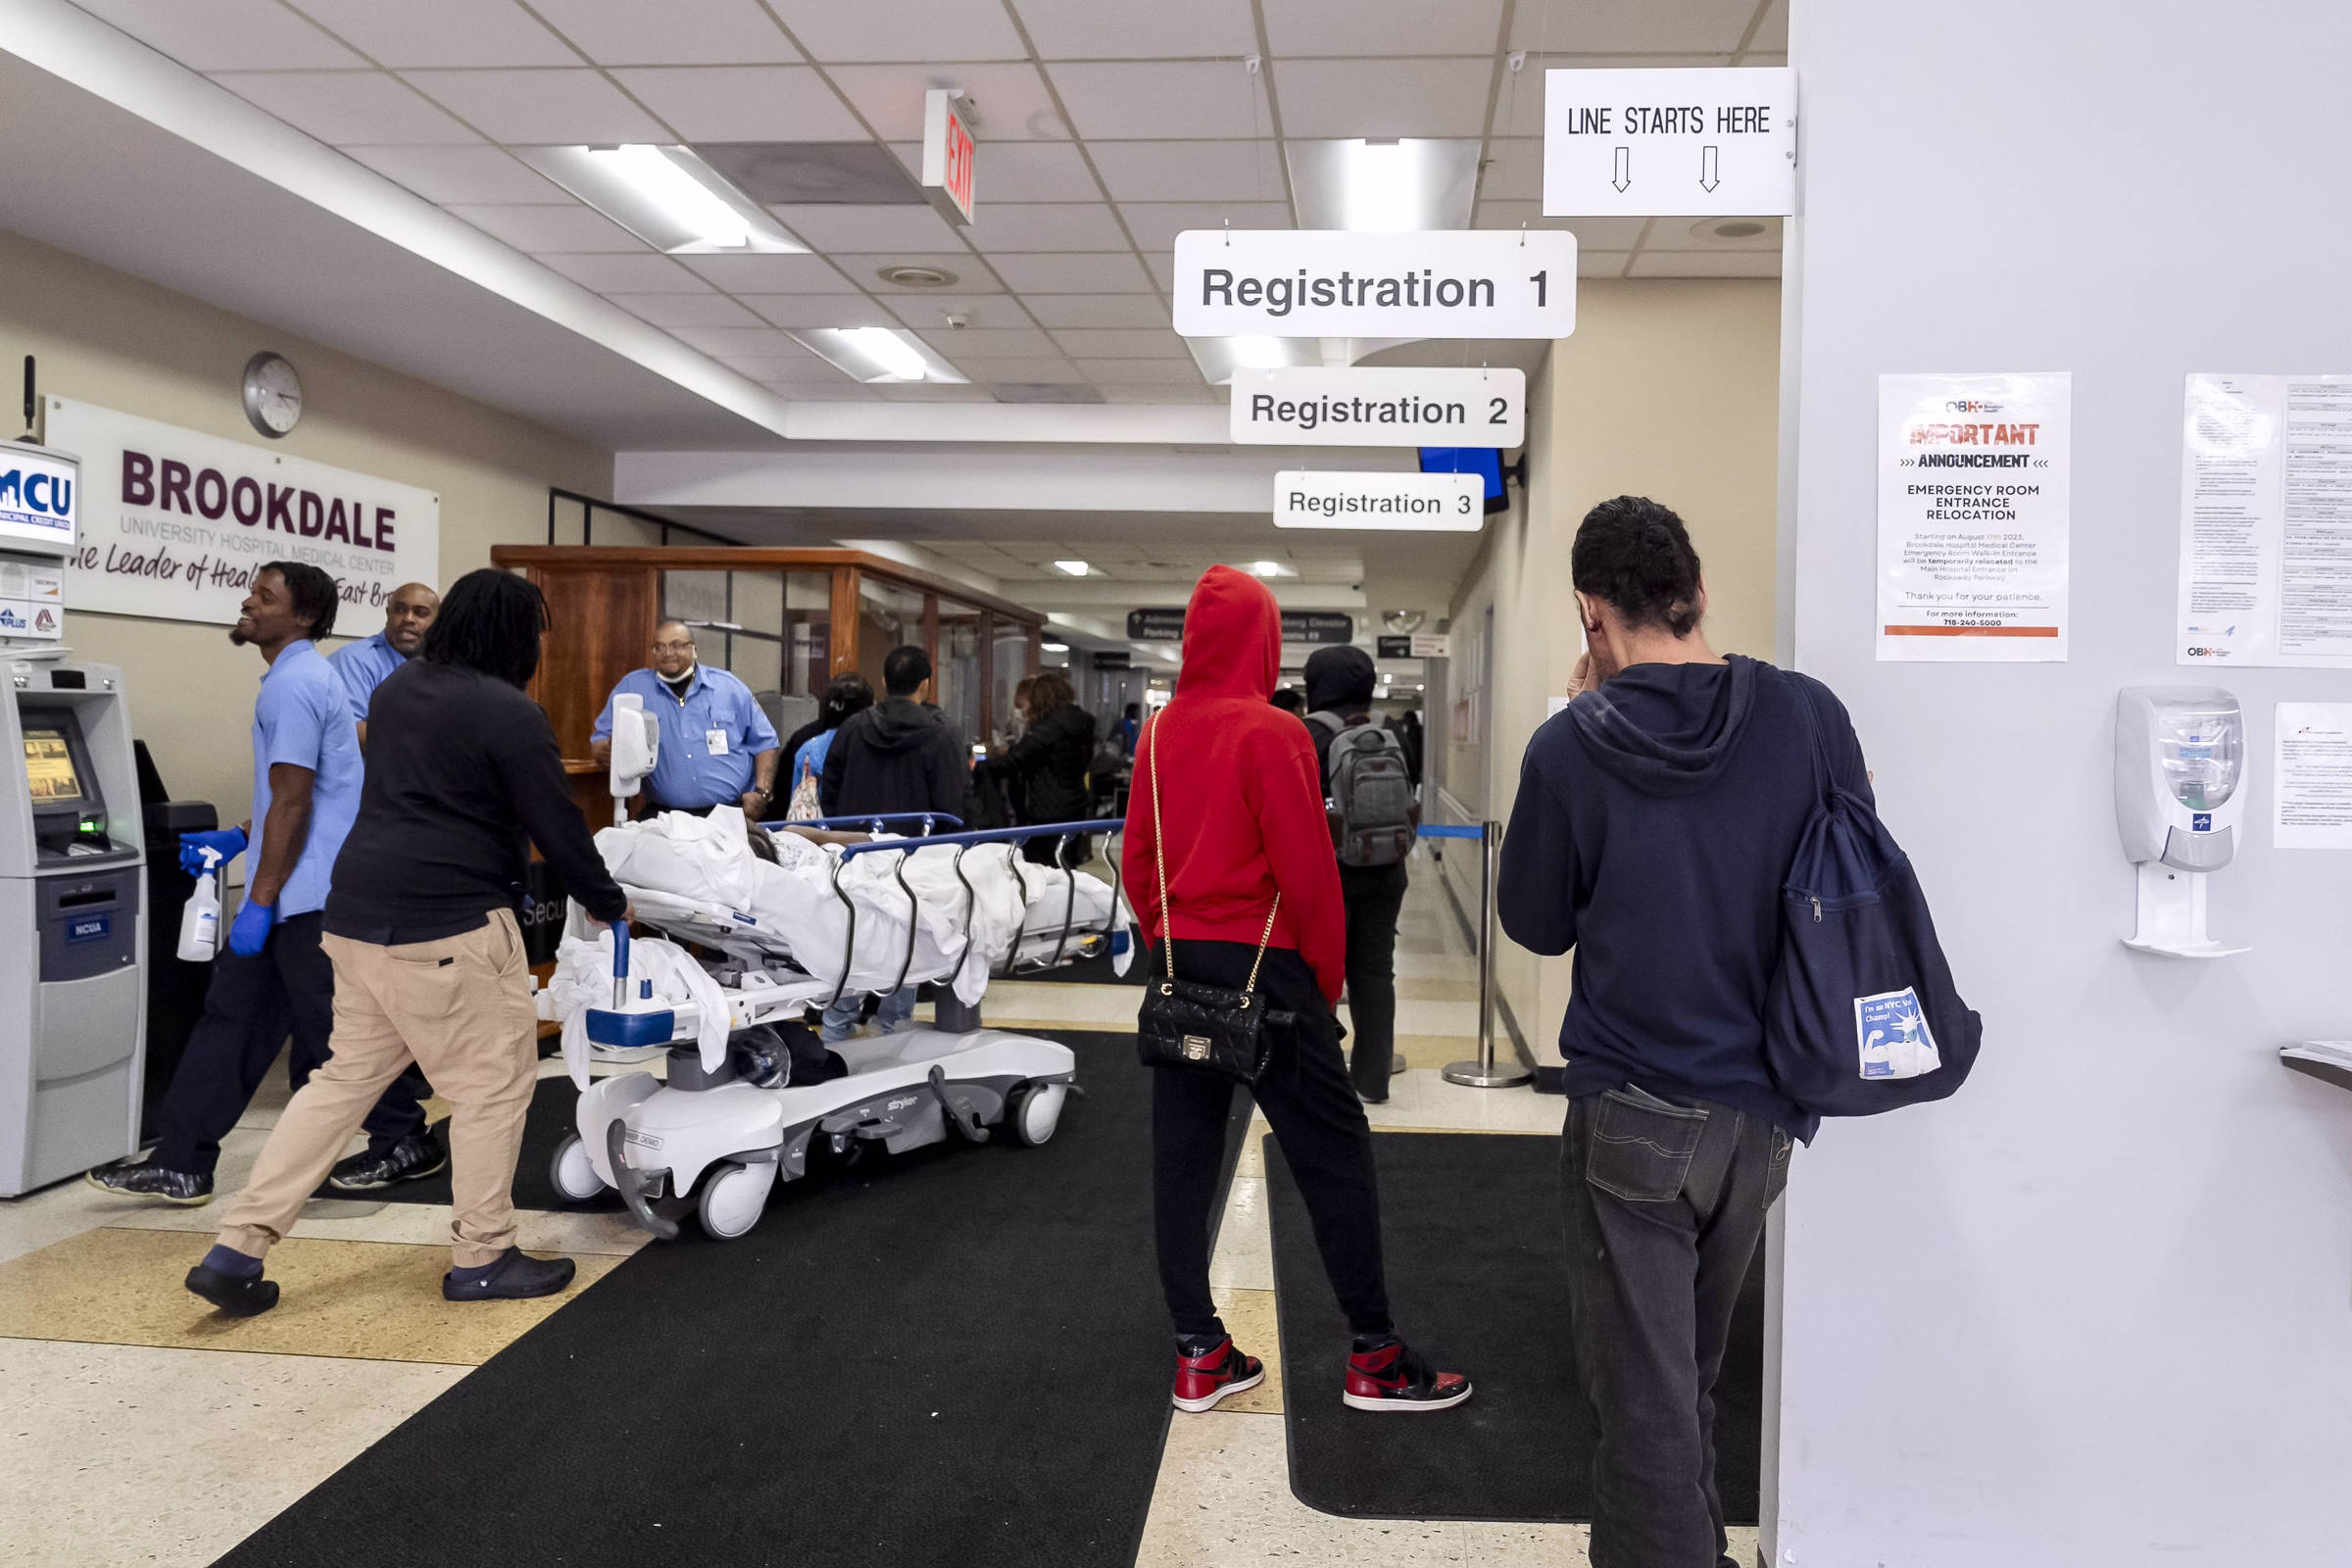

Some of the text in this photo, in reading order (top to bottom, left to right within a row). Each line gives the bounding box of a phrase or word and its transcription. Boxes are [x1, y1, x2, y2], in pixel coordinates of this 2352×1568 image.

[1568, 106, 1771, 134] LINE STARTS HERE
[948, 112, 973, 213] EXIT
[1202, 269, 1547, 317] Registration 1
[1251, 394, 1507, 429] Registration 2
[1918, 454, 2030, 467] ANNOUNCEMENT
[122, 449, 396, 553] BROOKDALE
[1907, 484, 2039, 495] EMERGENCY ROOM
[1289, 492, 1471, 516] Registration 3
[1927, 510, 2016, 520] RELOCATION
[1936, 497, 2010, 508] ENTRANCE
[121, 515, 395, 576] UNIVERSITY HOSPITAL MEDICAL CENTER
[105, 543, 182, 580] Leader
[186, 554, 209, 590] of
[210, 562, 259, 590] Heal
[335, 578, 368, 604] East
[1905, 592, 1934, 601] Thank
[1936, 593, 1953, 602] you
[1955, 592, 1970, 601] for
[1995, 593, 2043, 602] patience.
[523, 899, 564, 926] Secu
[75, 922, 102, 936] NCUA
[1885, 1001, 1902, 1009] NYC
[887, 1096, 918, 1111] stryker
